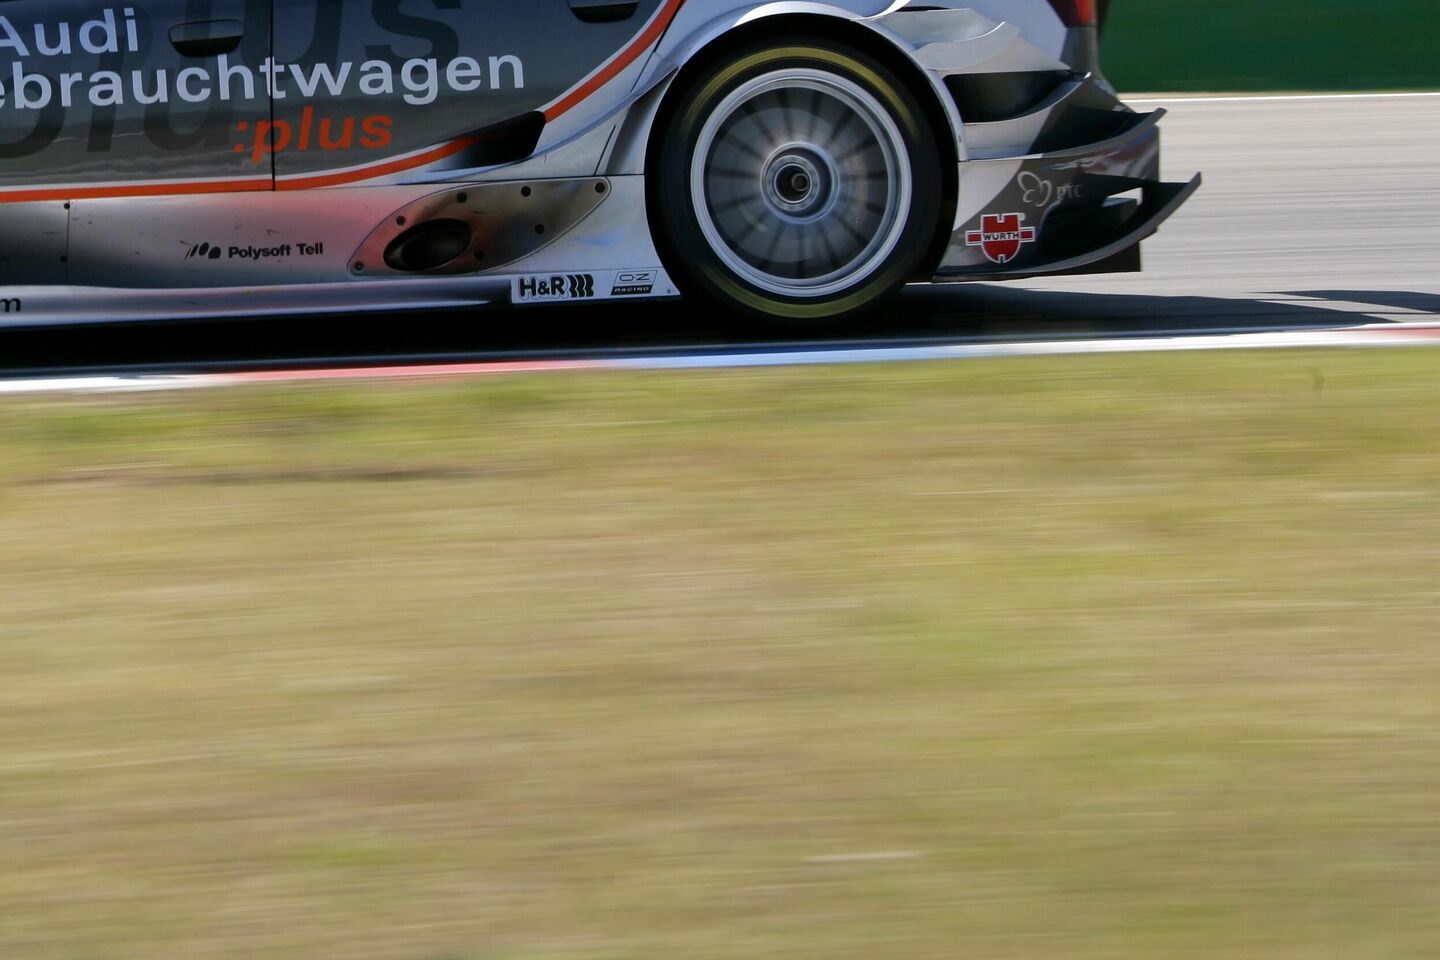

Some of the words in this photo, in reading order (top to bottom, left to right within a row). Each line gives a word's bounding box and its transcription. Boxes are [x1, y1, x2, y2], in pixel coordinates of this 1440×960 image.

[228, 244, 292, 260] Polysoft
[296, 242, 324, 255] Tell
[518, 276, 566, 297] H&R
